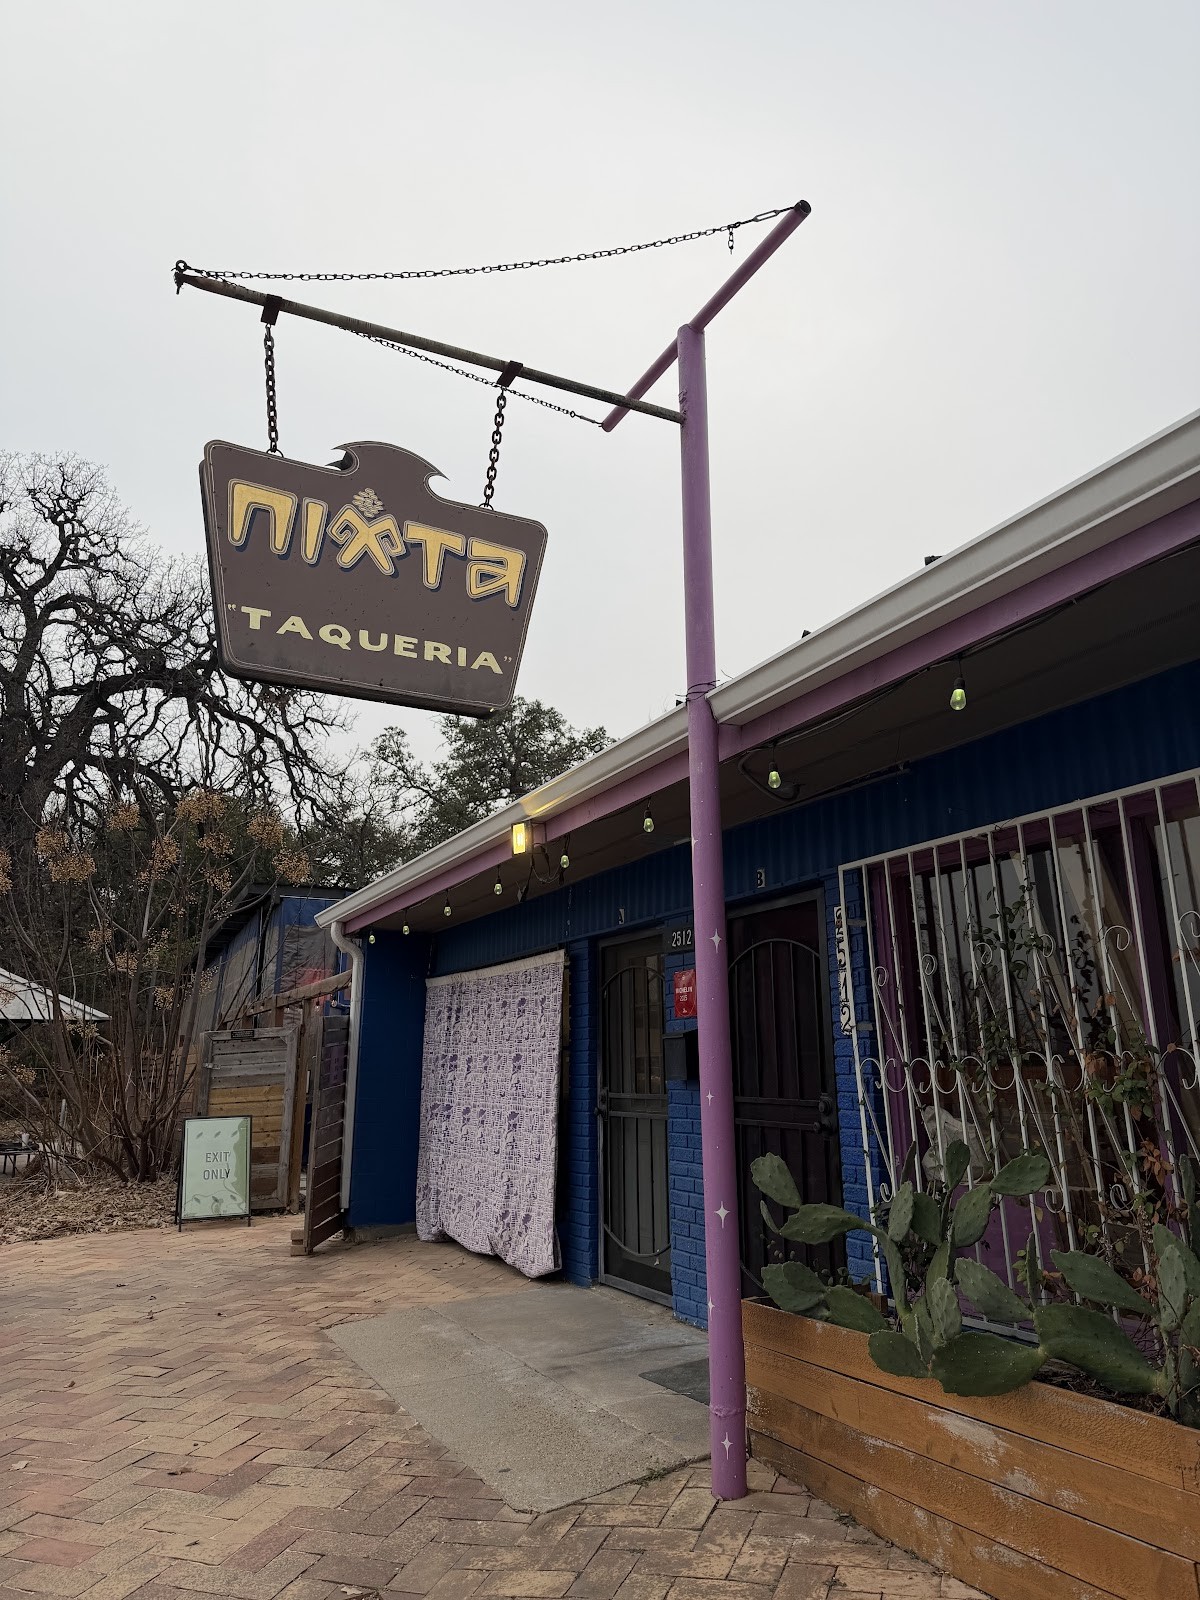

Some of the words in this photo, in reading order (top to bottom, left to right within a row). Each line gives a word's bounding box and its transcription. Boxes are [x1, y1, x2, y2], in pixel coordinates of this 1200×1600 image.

[671, 929, 692, 947] 2512
[205, 1151, 230, 1163] EXIT
[203, 1168, 231, 1180] ONLY
